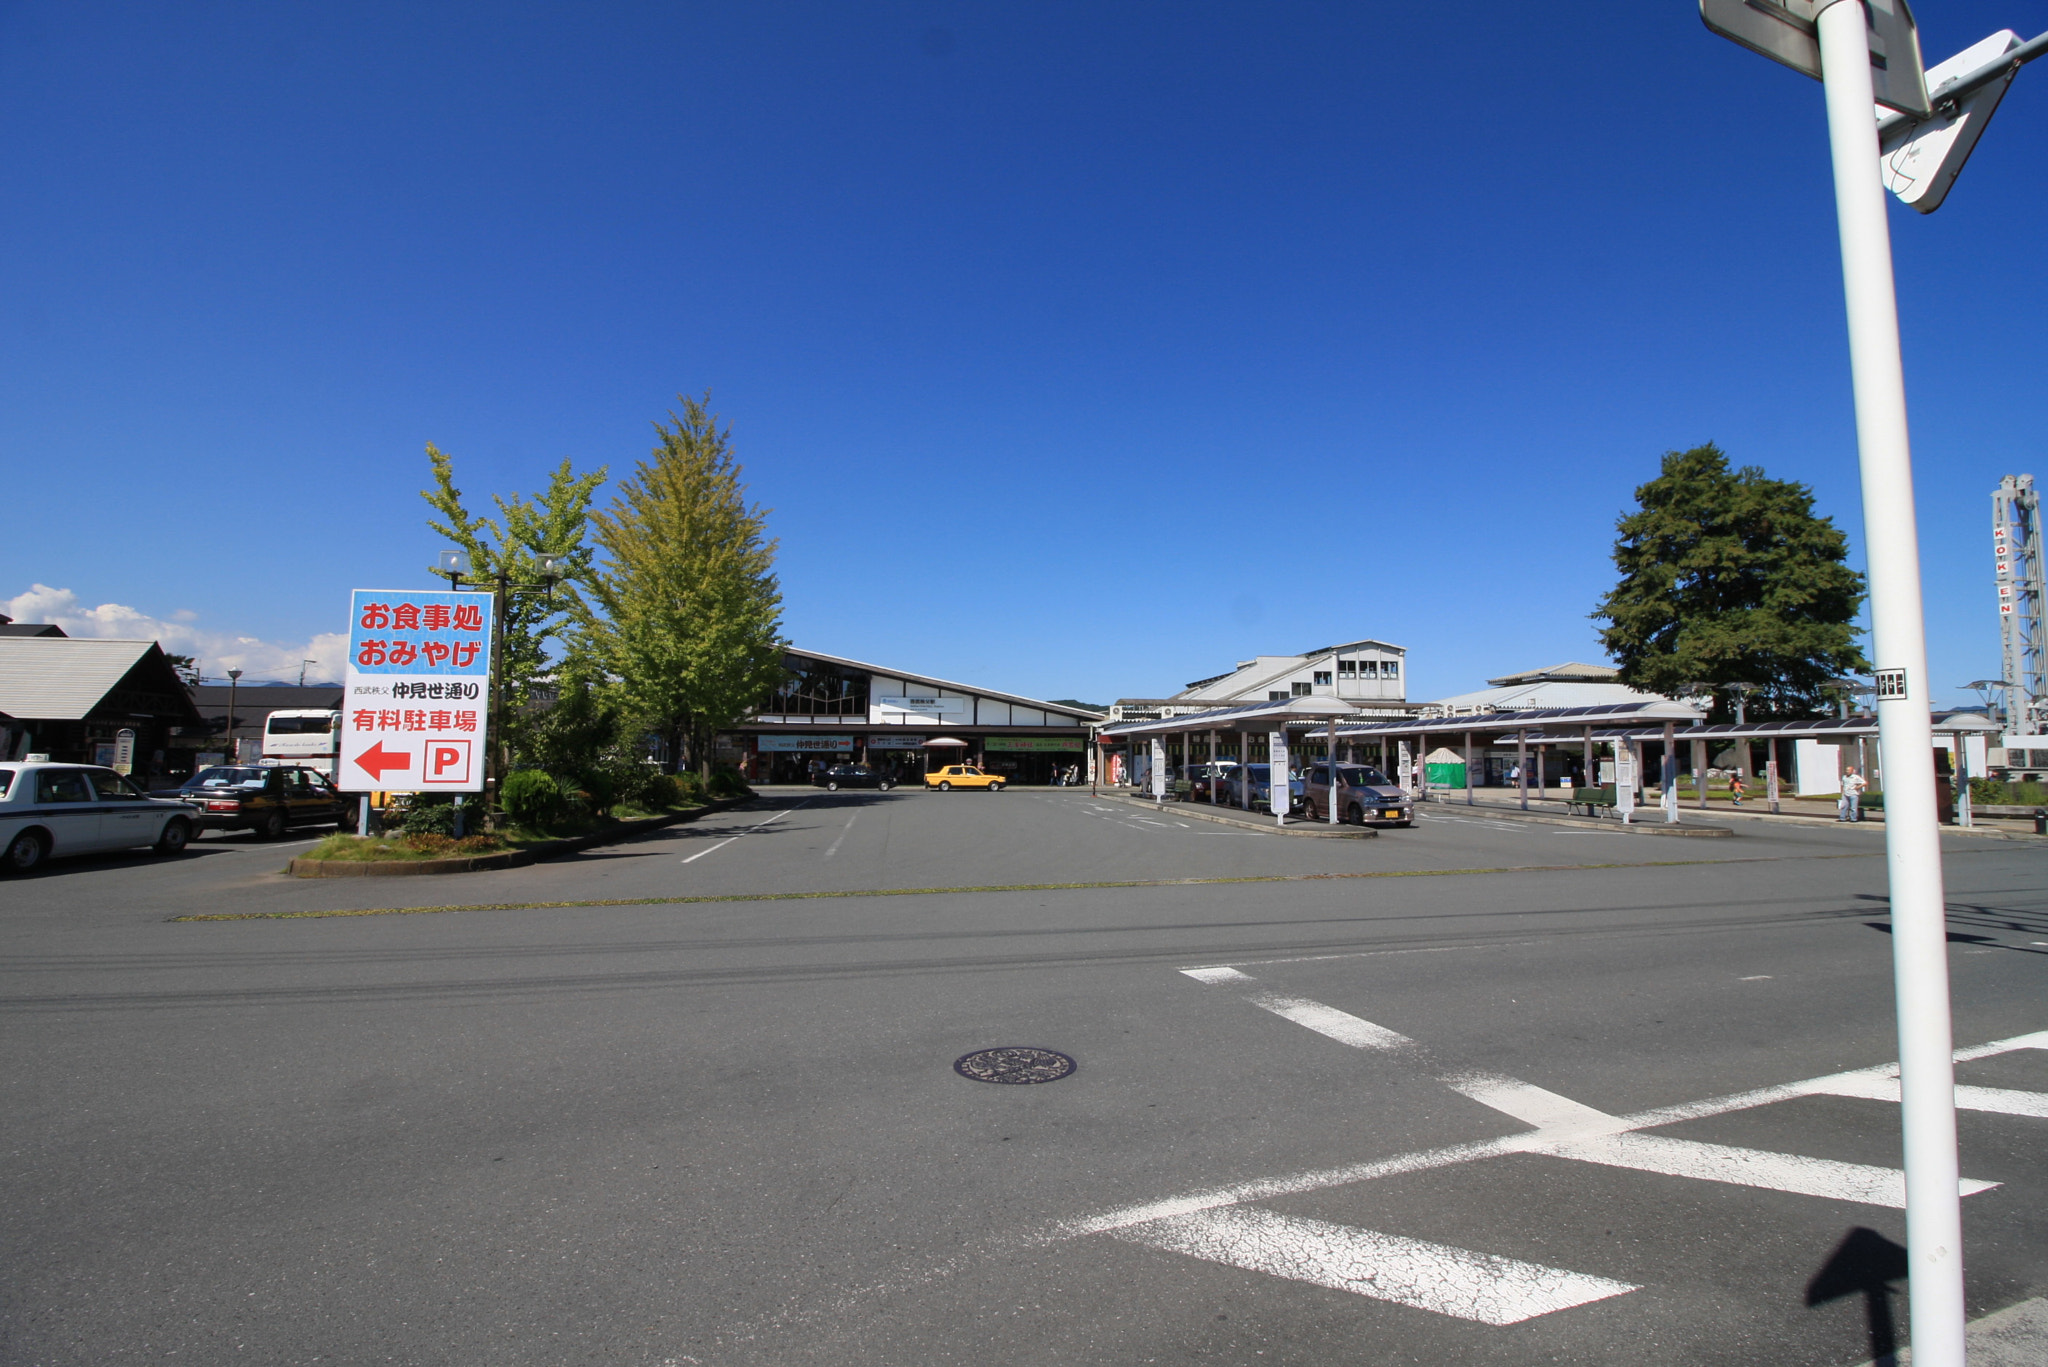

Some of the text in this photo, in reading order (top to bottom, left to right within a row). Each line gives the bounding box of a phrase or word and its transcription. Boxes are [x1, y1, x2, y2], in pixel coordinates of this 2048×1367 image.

[1995, 529, 2010, 612] KOKEN
[361, 603, 483, 631] お食事処
[358, 639, 482, 667] おみやげ
[354, 682, 479, 699] 西武秩父 仲見世通り
[353, 709, 477, 732] 有料駐車場
[434, 748, 460, 775] P
